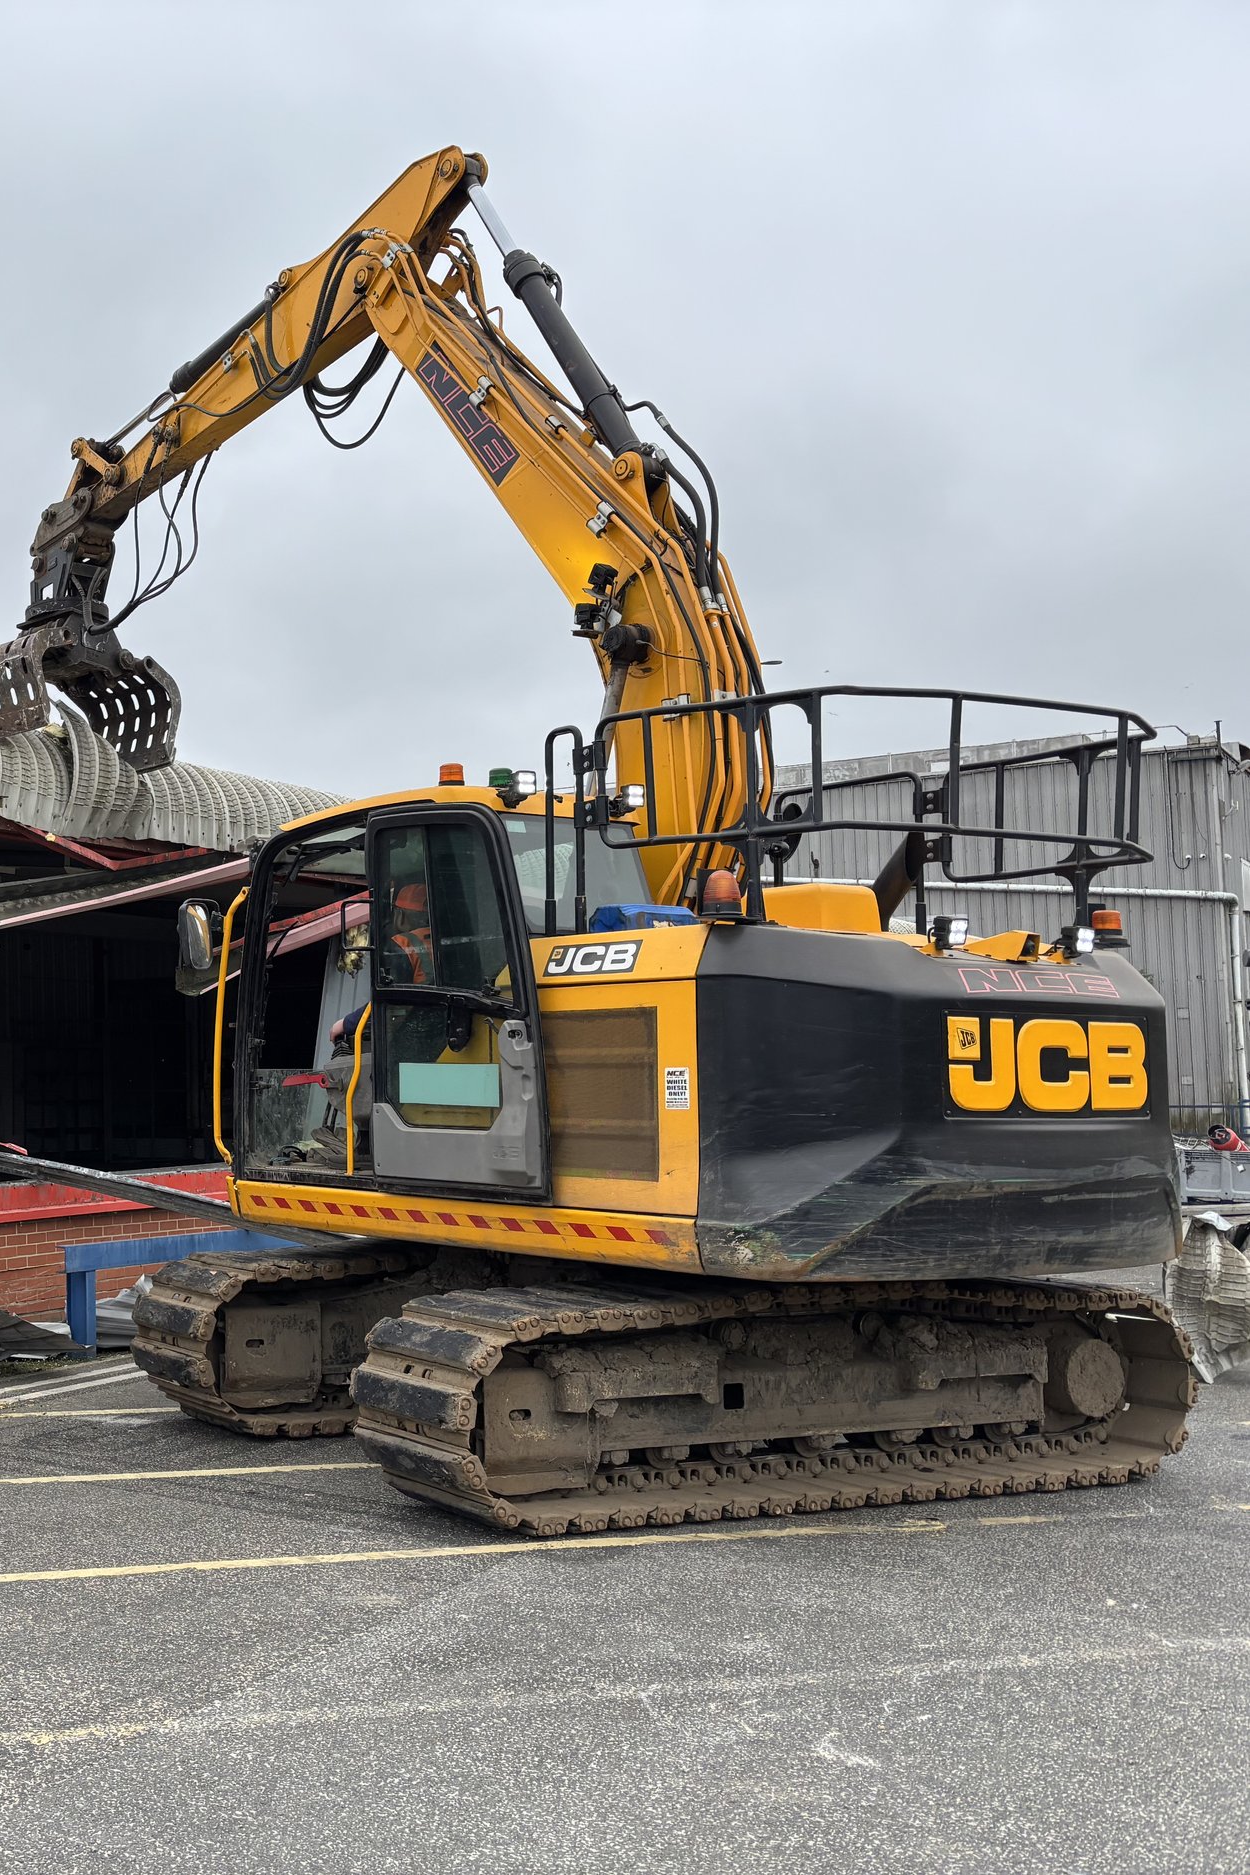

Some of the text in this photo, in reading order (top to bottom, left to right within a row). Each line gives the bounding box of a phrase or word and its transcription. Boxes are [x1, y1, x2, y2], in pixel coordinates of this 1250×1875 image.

[419, 351, 516, 473] NCE
[547, 943, 637, 974] JCB
[958, 968, 1120, 998] NCE
[960, 1030, 976, 1047] JCB
[947, 1016, 1148, 1112] JCB
